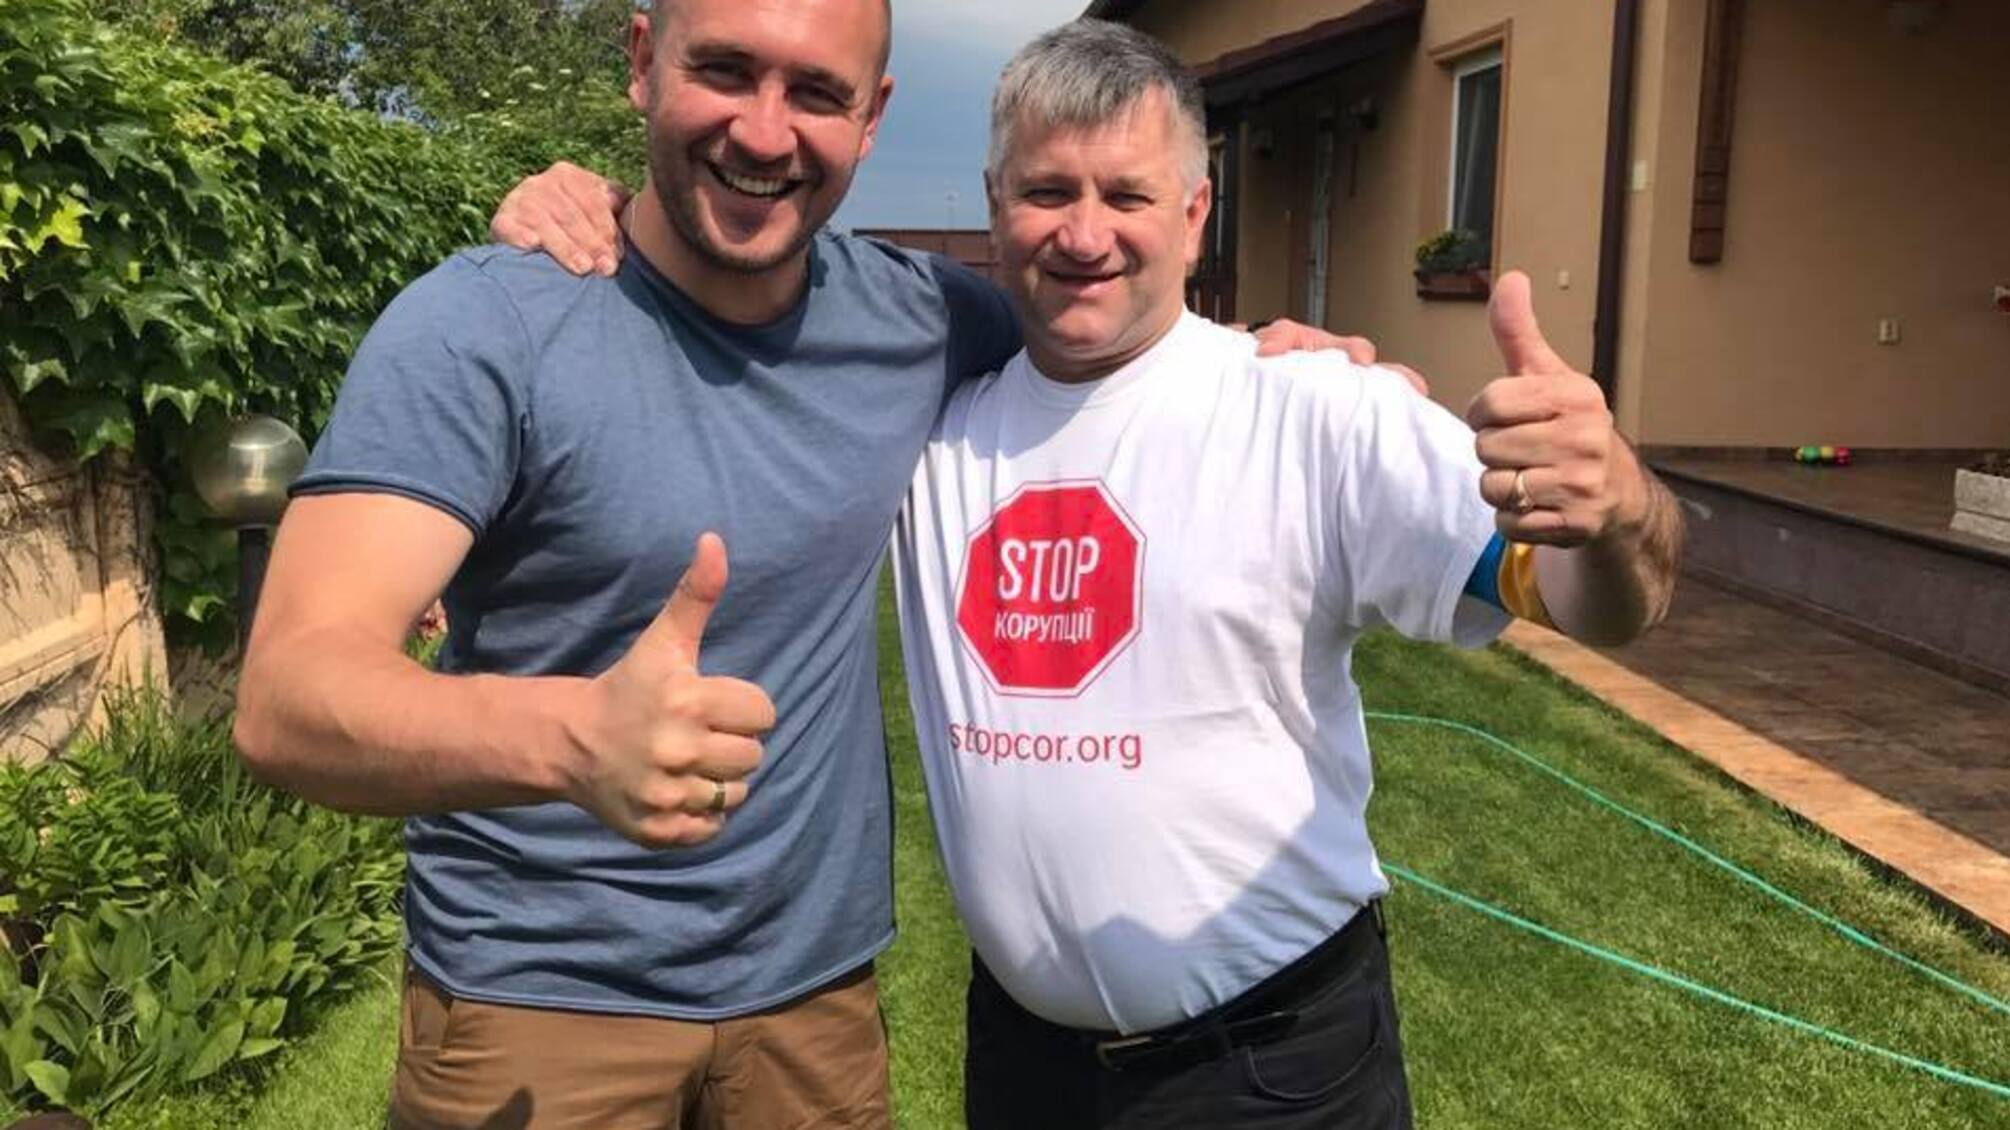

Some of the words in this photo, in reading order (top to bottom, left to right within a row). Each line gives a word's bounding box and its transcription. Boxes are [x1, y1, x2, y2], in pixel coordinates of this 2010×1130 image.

[998, 535, 1100, 602] STOP
[994, 607, 1095, 644] КОРУПЦІЇ
[949, 721, 1142, 769] stopcor.org
